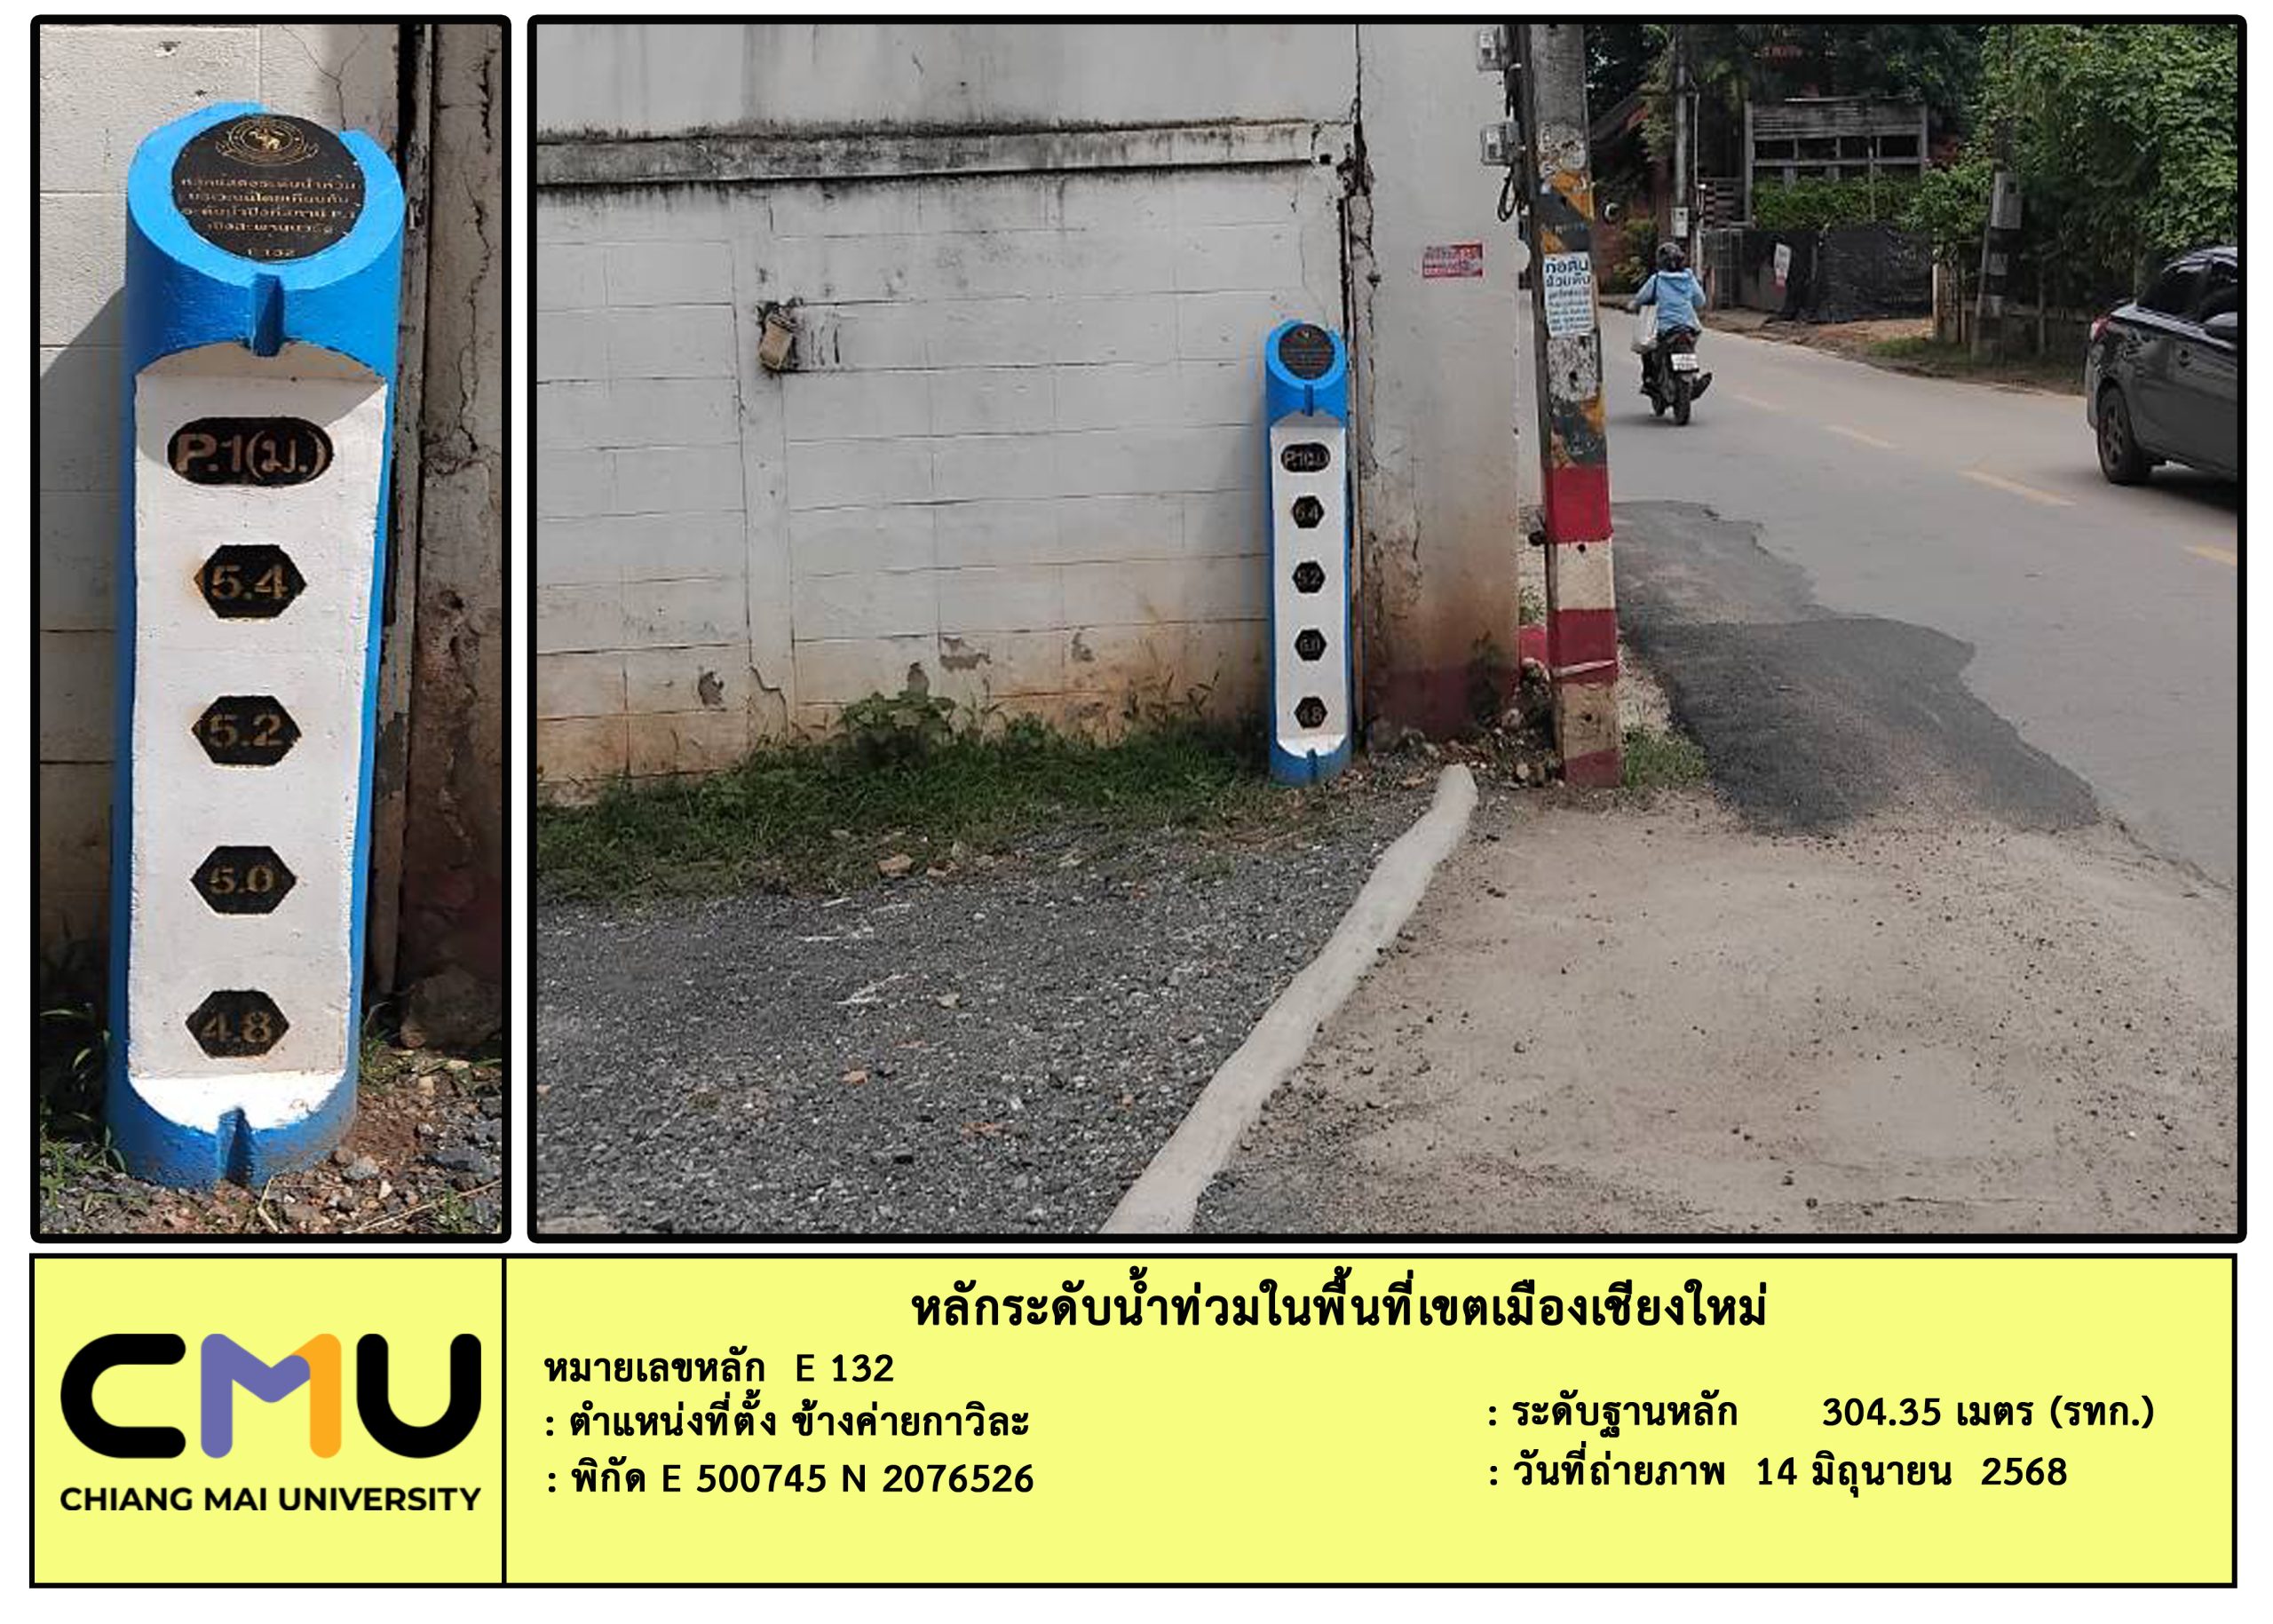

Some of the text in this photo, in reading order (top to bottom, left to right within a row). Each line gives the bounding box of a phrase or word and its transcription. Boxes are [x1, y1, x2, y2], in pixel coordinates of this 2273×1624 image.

[175, 429, 328, 479] P.1(ม.)
[211, 565, 289, 599] 5.4
[210, 713, 284, 748] 5.2
[210, 865, 277, 895] 5.0
[201, 1010, 273, 1043] 4.8
